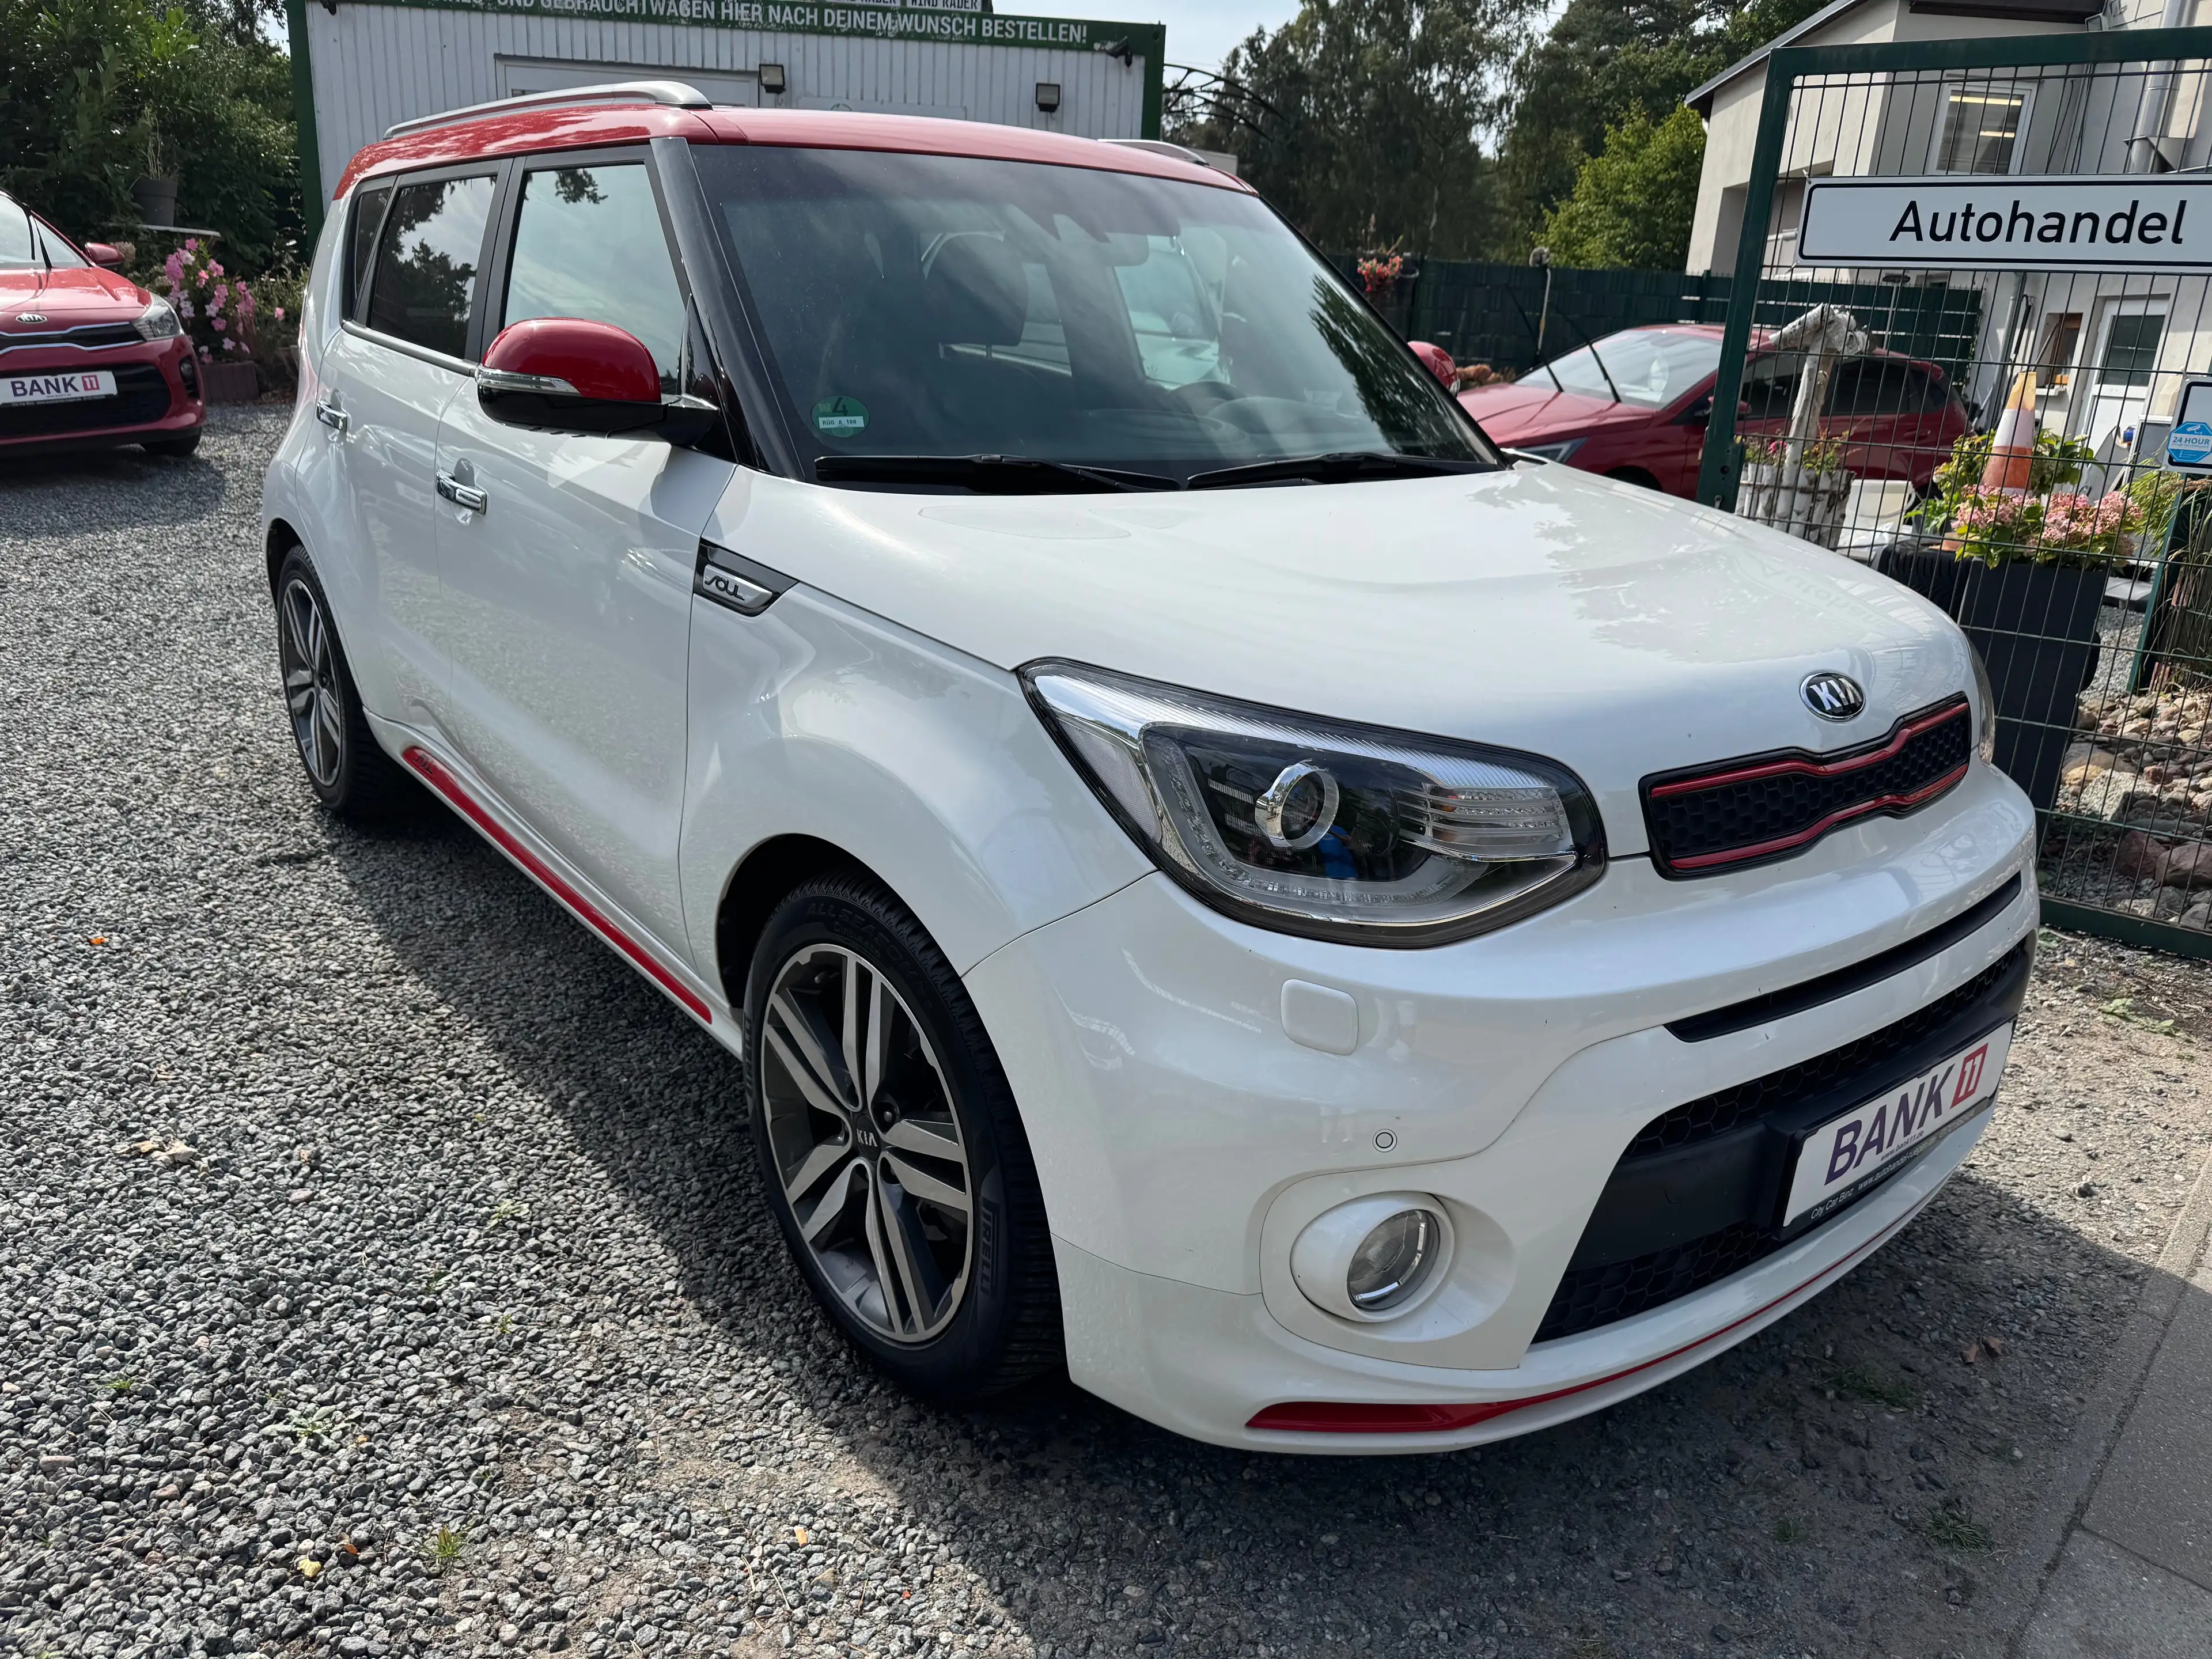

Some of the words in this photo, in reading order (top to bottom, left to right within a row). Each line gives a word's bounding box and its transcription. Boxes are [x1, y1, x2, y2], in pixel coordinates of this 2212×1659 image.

[721, 1, 763, 23] HIER
[768, 5, 818, 26] NACH
[824, 8, 892, 31] DEINEM
[896, 13, 976, 36] WUNSCH
[982, 18, 1088, 43] BESTELLEN!
[1888, 199, 2188, 245] Autohandel
[10, 376, 80, 397] BANK
[82, 376, 99, 390] 11
[832, 396, 849, 416] 4
[2184, 437, 2210, 446] HOUR
[704, 574, 745, 601] SOUL
[1809, 677, 1863, 711] KIA
[1824, 1063, 1955, 1186] BANK
[1955, 1048, 1986, 1103] 11
[857, 1128, 878, 1147] KIA
[1810, 1205, 1824, 1219] City
[1825, 1196, 1838, 1211] Car
